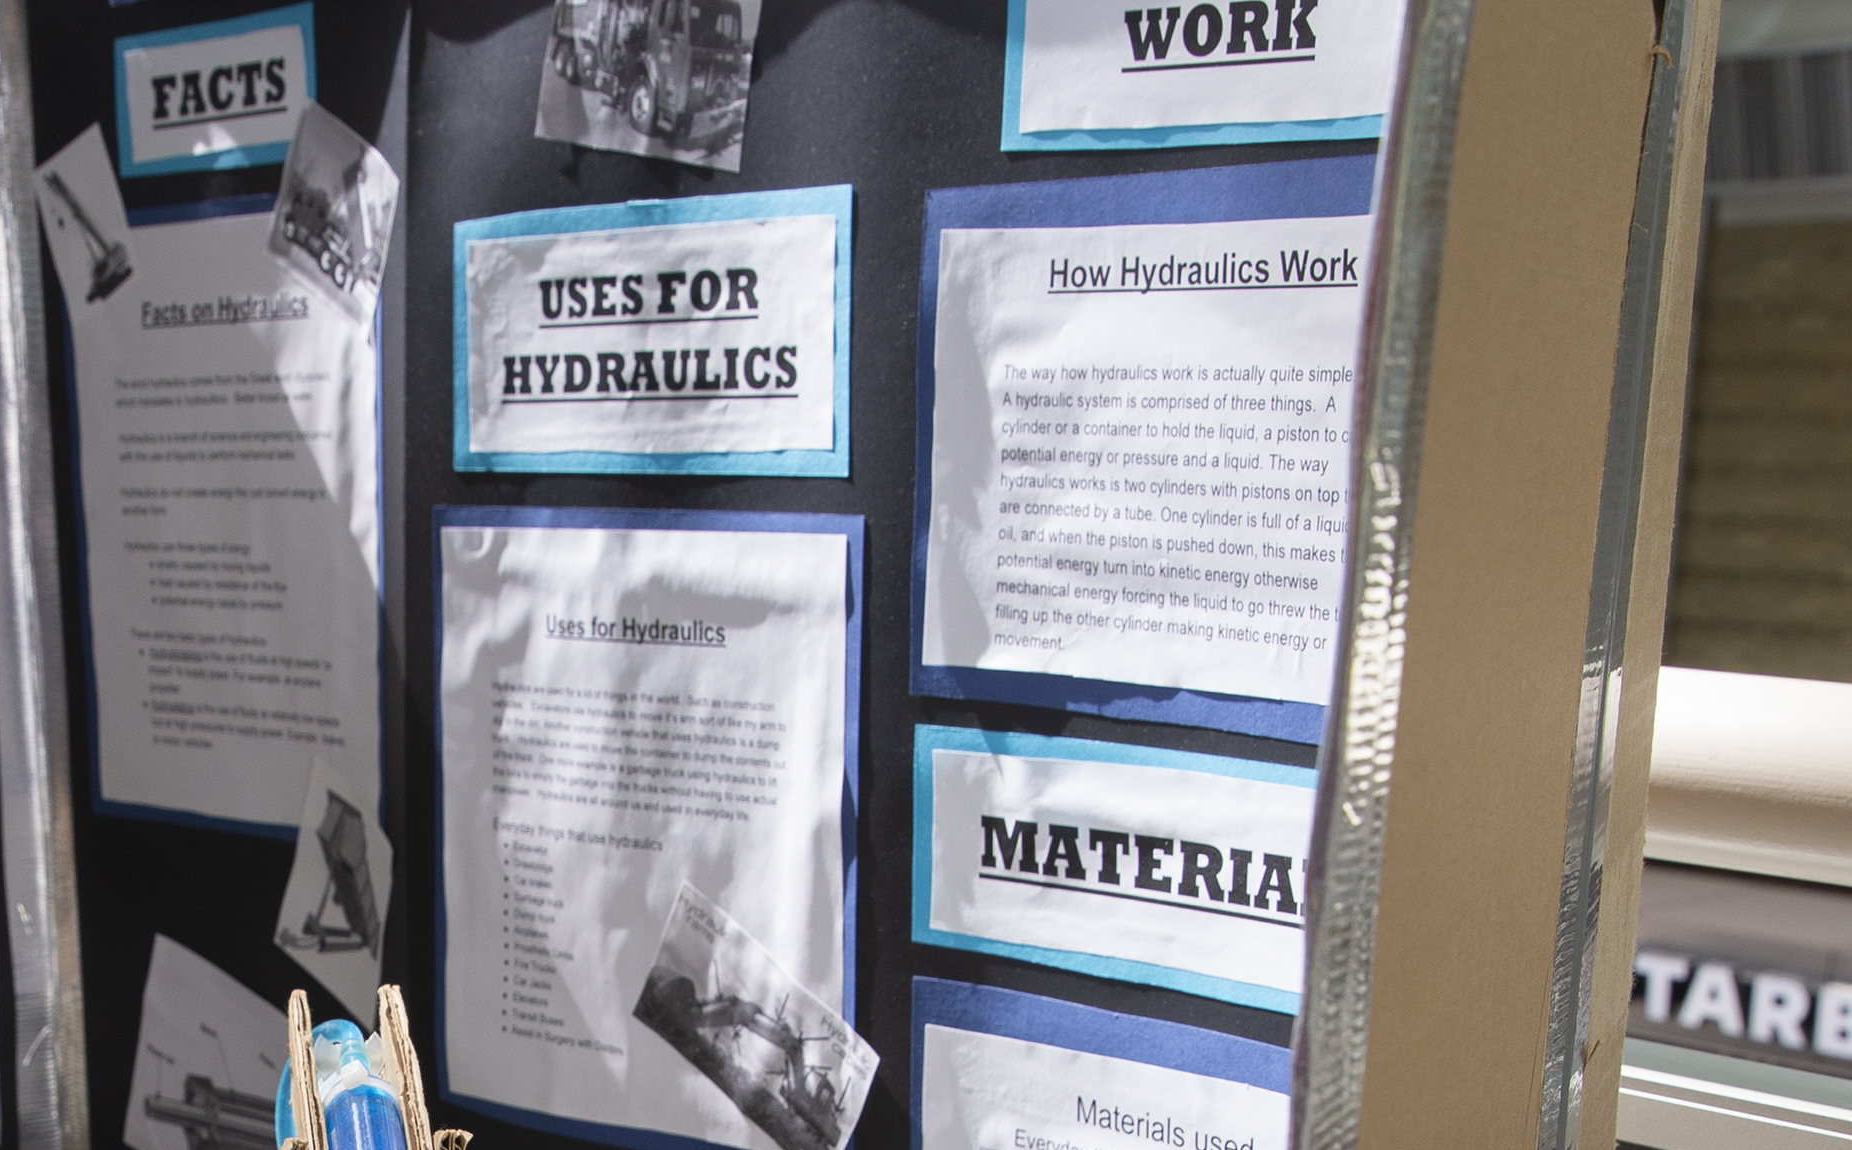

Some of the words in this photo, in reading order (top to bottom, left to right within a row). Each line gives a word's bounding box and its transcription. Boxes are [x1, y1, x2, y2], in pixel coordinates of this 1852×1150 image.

[1124, 0, 1317, 62] WORK
[152, 57, 286, 120] FACTS
[1049, 258, 1111, 289] How
[1120, 253, 1270, 294] Hydraulics
[1280, 249, 1359, 282] Work
[141, 299, 188, 325] Facts
[191, 301, 214, 322] on
[218, 293, 309, 323] Hydraulics
[539, 274, 644, 319] USES
[657, 267, 759, 314] FOR
[503, 346, 798, 394] HYDRAULICS
[1004, 364, 1027, 380] The
[1031, 368, 1057, 384] way
[1060, 365, 1088, 386] how
[1091, 364, 1158, 385] hydraulics
[1161, 364, 1194, 381] work
[1197, 364, 1209, 381] is
[1212, 364, 1266, 386] actually
[1269, 365, 1304, 387] quite
[1002, 391, 1013, 407] A
[1015, 391, 1074, 412] hydraulic
[1077, 392, 1122, 412] system
[1126, 392, 1137, 409] is
[1140, 393, 1210, 413] comprised
[1213, 393, 1228, 410] of
[1231, 393, 1266, 411] three
[1325, 396, 1336, 413] A
[1001, 418, 1052, 438] cylinder
[1054, 422, 1069, 436] or
[1071, 423, 1080, 436] a
[1084, 420, 1143, 437] container
[1146, 422, 1158, 438] to
[1162, 421, 1190, 438] hold
[1194, 422, 1215, 439] the
[1263, 428, 1272, 441] a
[1276, 424, 1320, 446] piston
[1324, 426, 1337, 443] to
[1000, 445, 1057, 469] potential
[1059, 449, 1104, 468] energy
[1106, 451, 1120, 464] or
[1122, 452, 1179, 469] pressure
[1182, 451, 1208, 468] and
[1211, 455, 1220, 469] a
[1269, 453, 1296, 472] The
[1300, 458, 1329, 477] way
[1000, 472, 1066, 491] hydraulics
[1068, 475, 1106, 492] works
[1110, 476, 1120, 492] is
[1124, 477, 1146, 494] two
[1149, 478, 1207, 499] cylinders
[1210, 480, 1238, 498] with
[1241, 482, 1291, 503] pistons
[1294, 488, 1313, 503] on
[1317, 485, 1340, 510] top
[999, 502, 1021, 515] are
[1024, 502, 1090, 517] connected
[1094, 503, 1109, 523] by
[1113, 507, 1121, 520] a
[1160, 505, 1188, 524] One
[1191, 508, 1243, 529] cylinder
[1246, 511, 1258, 528] is
[1261, 511, 1282, 530] full
[1285, 513, 1301, 531] of
[1303, 518, 1312, 531] a
[1021, 529, 1044, 543] and
[1048, 529, 1082, 545] when
[1086, 530, 1106, 547] the
[1109, 533, 1148, 551] piston
[1152, 534, 1165, 551] is
[1166, 536, 1215, 555] pushed
[1262, 541, 1286, 559] this
[1290, 544, 1336, 563] makes
[997, 552, 1053, 571] potential
[1056, 556, 1100, 577] energy
[1103, 559, 1128, 576] turn
[1131, 559, 1156, 576] into
[1159, 562, 1201, 580] kinetic
[1204, 569, 1250, 589] energy
[1254, 572, 1319, 591] otherwise
[995, 579, 1070, 598] mechanical
[1074, 586, 1119, 605] energy
[1121, 583, 1169, 610] forcing
[1169, 590, 1190, 608] the
[1193, 592, 1228, 613] liquid
[1231, 596, 1244, 613] to
[1247, 601, 1265, 618] go
[1268, 599, 1306, 618] threw
[1309, 603, 1330, 621] the
[546, 614, 585, 637] Uses
[591, 614, 616, 638] for
[622, 617, 726, 644] Hydraulics
[995, 603, 1029, 625] filling
[1032, 604, 1049, 627] up
[1052, 608, 1073, 625] the
[1075, 611, 1111, 631] other
[1113, 614, 1164, 634] cylinder
[1167, 620, 1214, 642] making
[1218, 623, 1260, 643] kinetic
[1263, 631, 1310, 655] energy
[1313, 637, 1327, 650] or
[980, 814, 1304, 918] MATERIA
[1076, 1096, 1185, 1148] Materials
